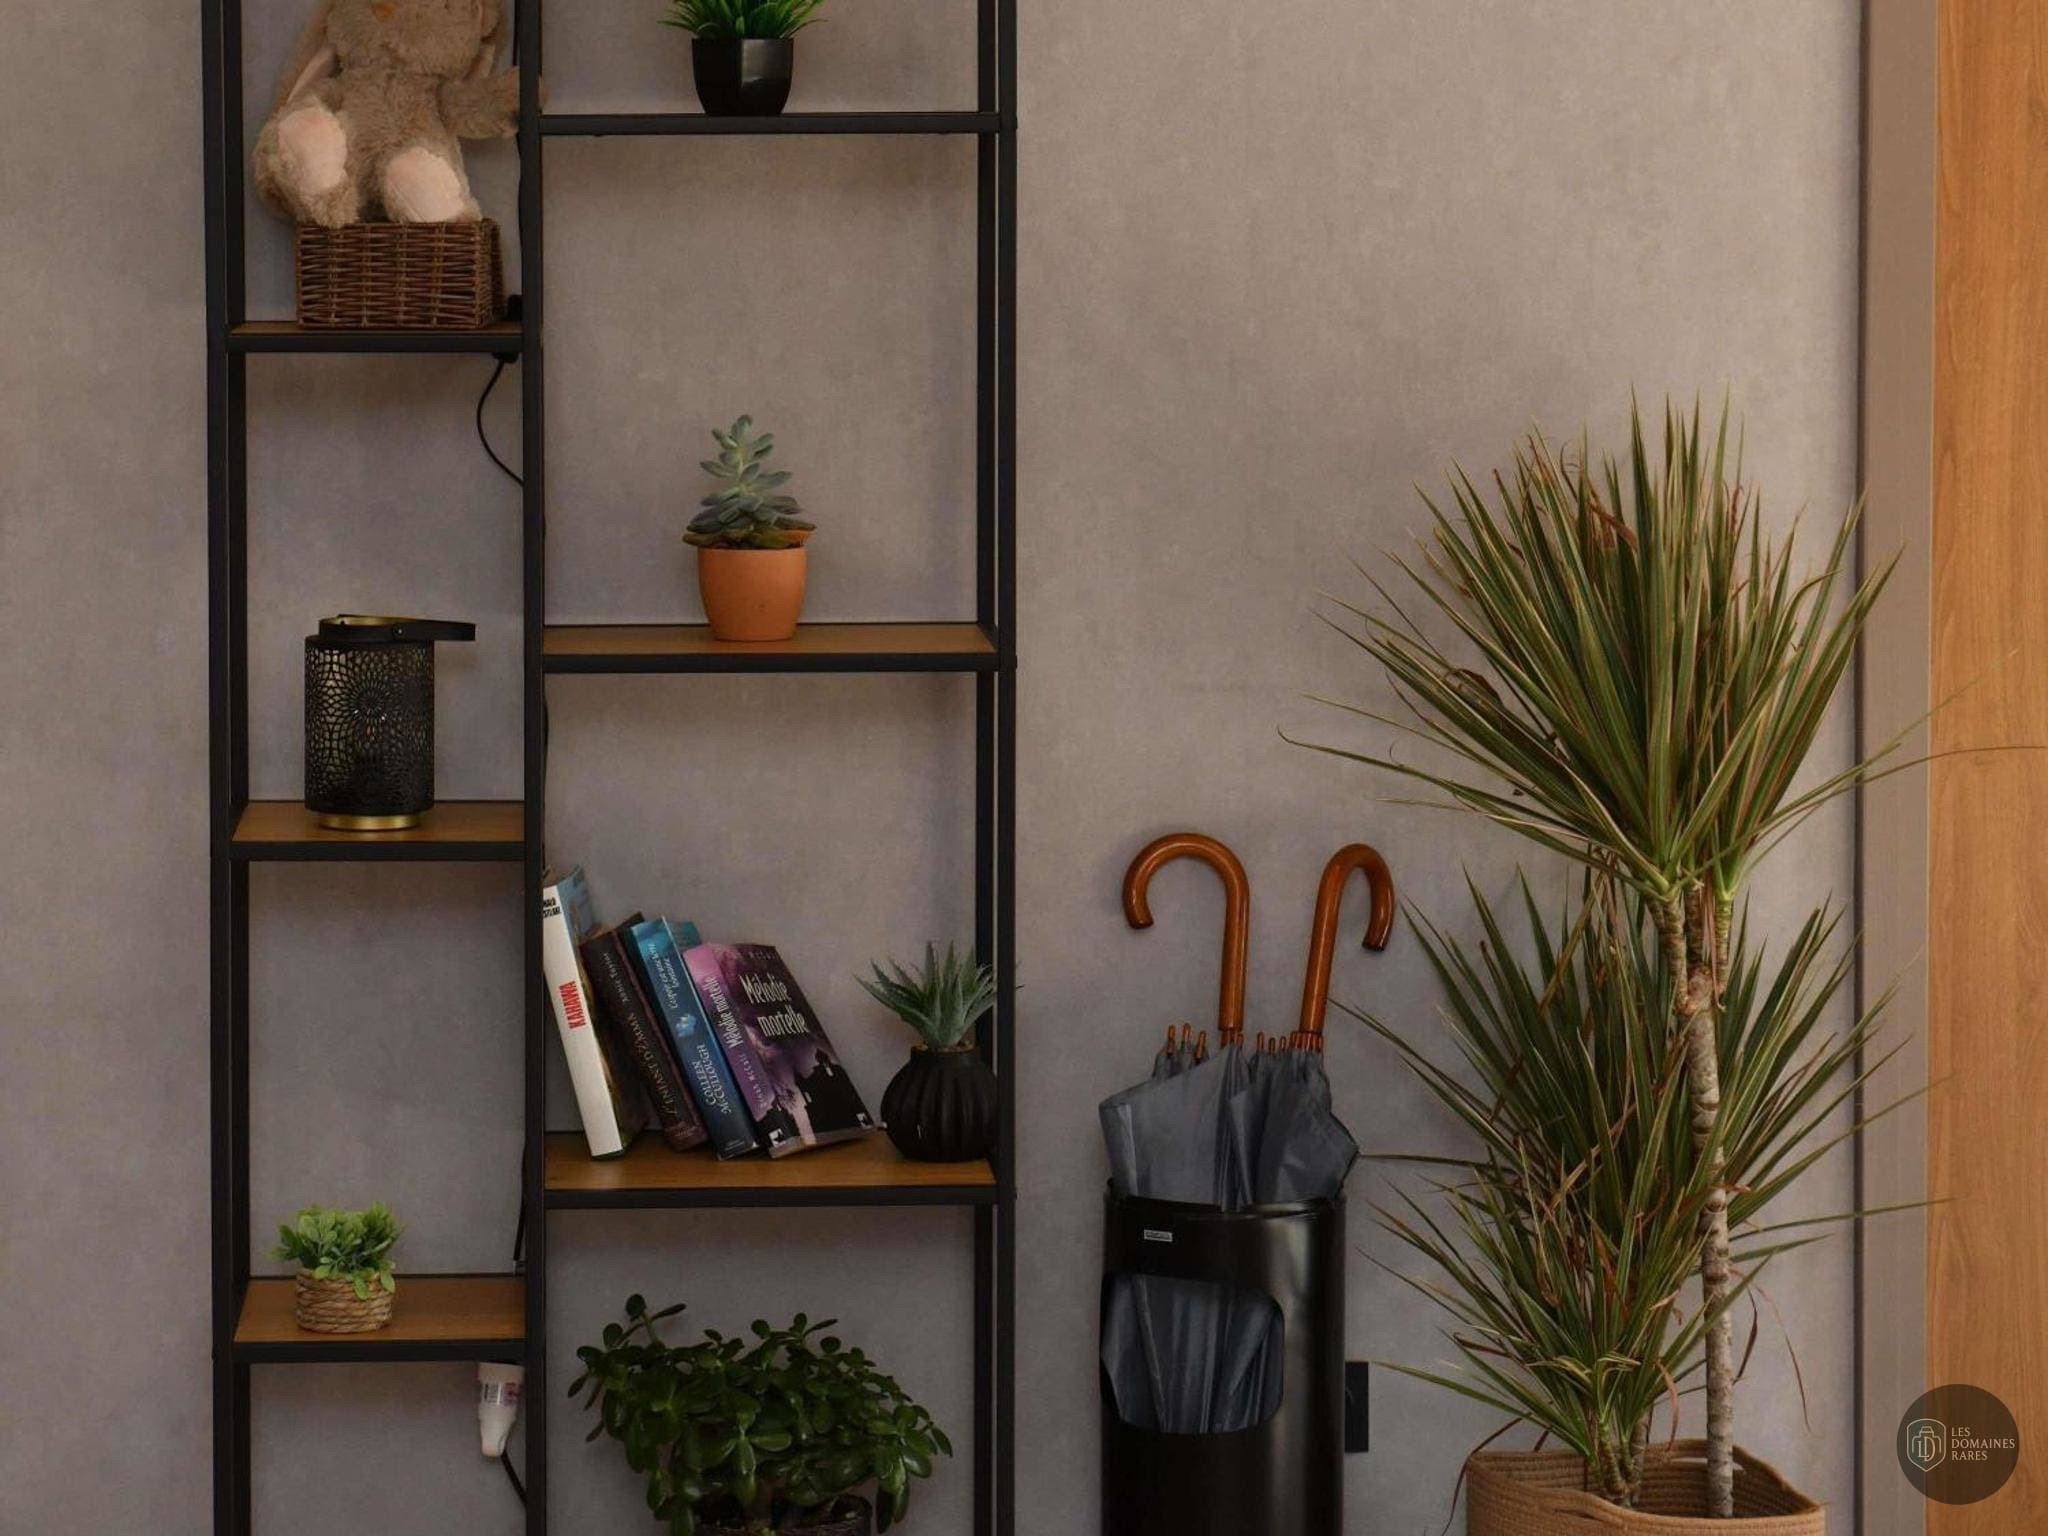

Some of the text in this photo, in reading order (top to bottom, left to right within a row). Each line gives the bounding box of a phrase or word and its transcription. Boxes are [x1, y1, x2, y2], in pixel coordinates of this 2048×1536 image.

[702, 974, 730, 1013] mortelle
[739, 973, 792, 1003] Mélodie
[757, 1004, 810, 1037] mortelle
[690, 1059, 717, 1106] COLLEEN
